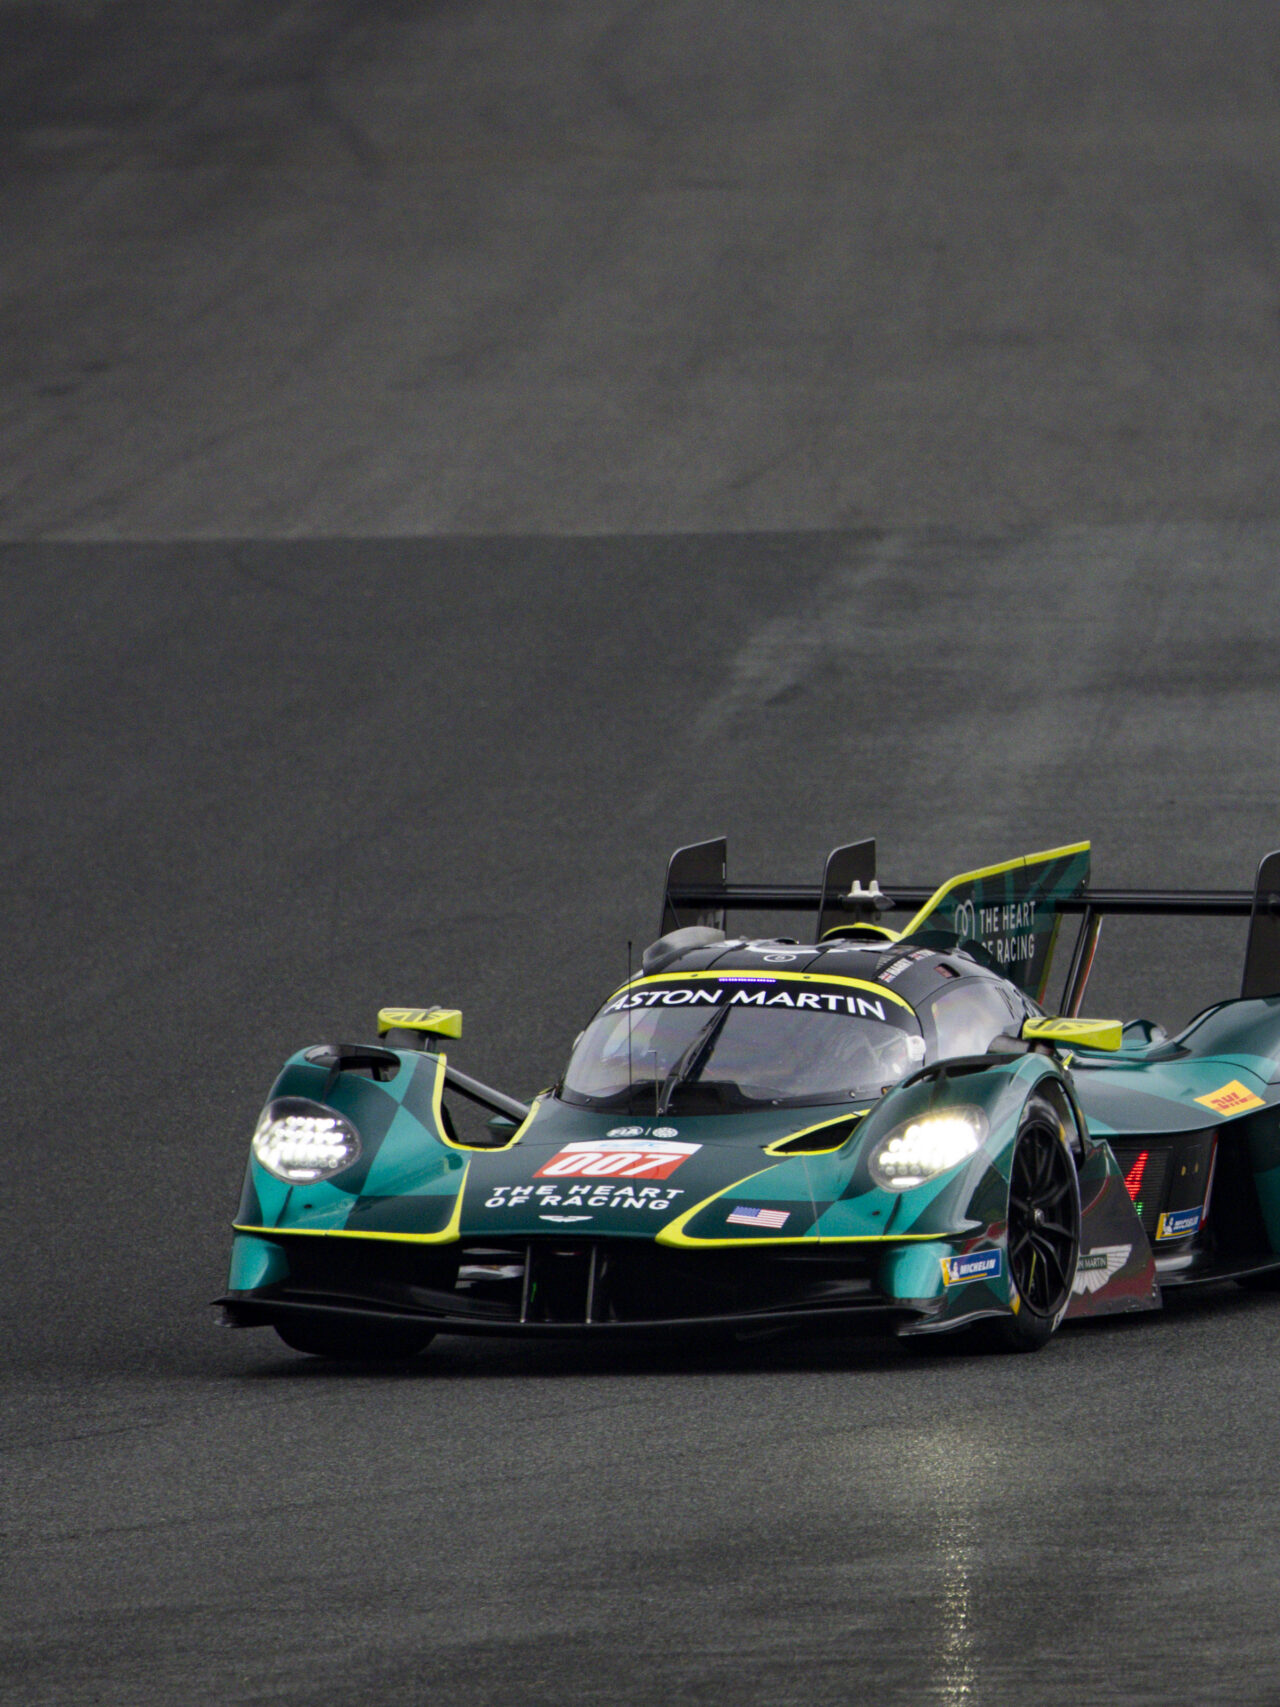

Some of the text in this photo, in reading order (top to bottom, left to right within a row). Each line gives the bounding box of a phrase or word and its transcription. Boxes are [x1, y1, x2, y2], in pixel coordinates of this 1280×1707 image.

[979, 901, 1036, 935] THE HEART
[997, 933, 1035, 964] RACING
[603, 989, 887, 1021] ASTON MARTIN
[541, 1152, 683, 1176] 007
[485, 1195, 670, 1210] OF RACING
[493, 1184, 685, 1200] THE HEART
[959, 1259, 997, 1275] MICHELIN
